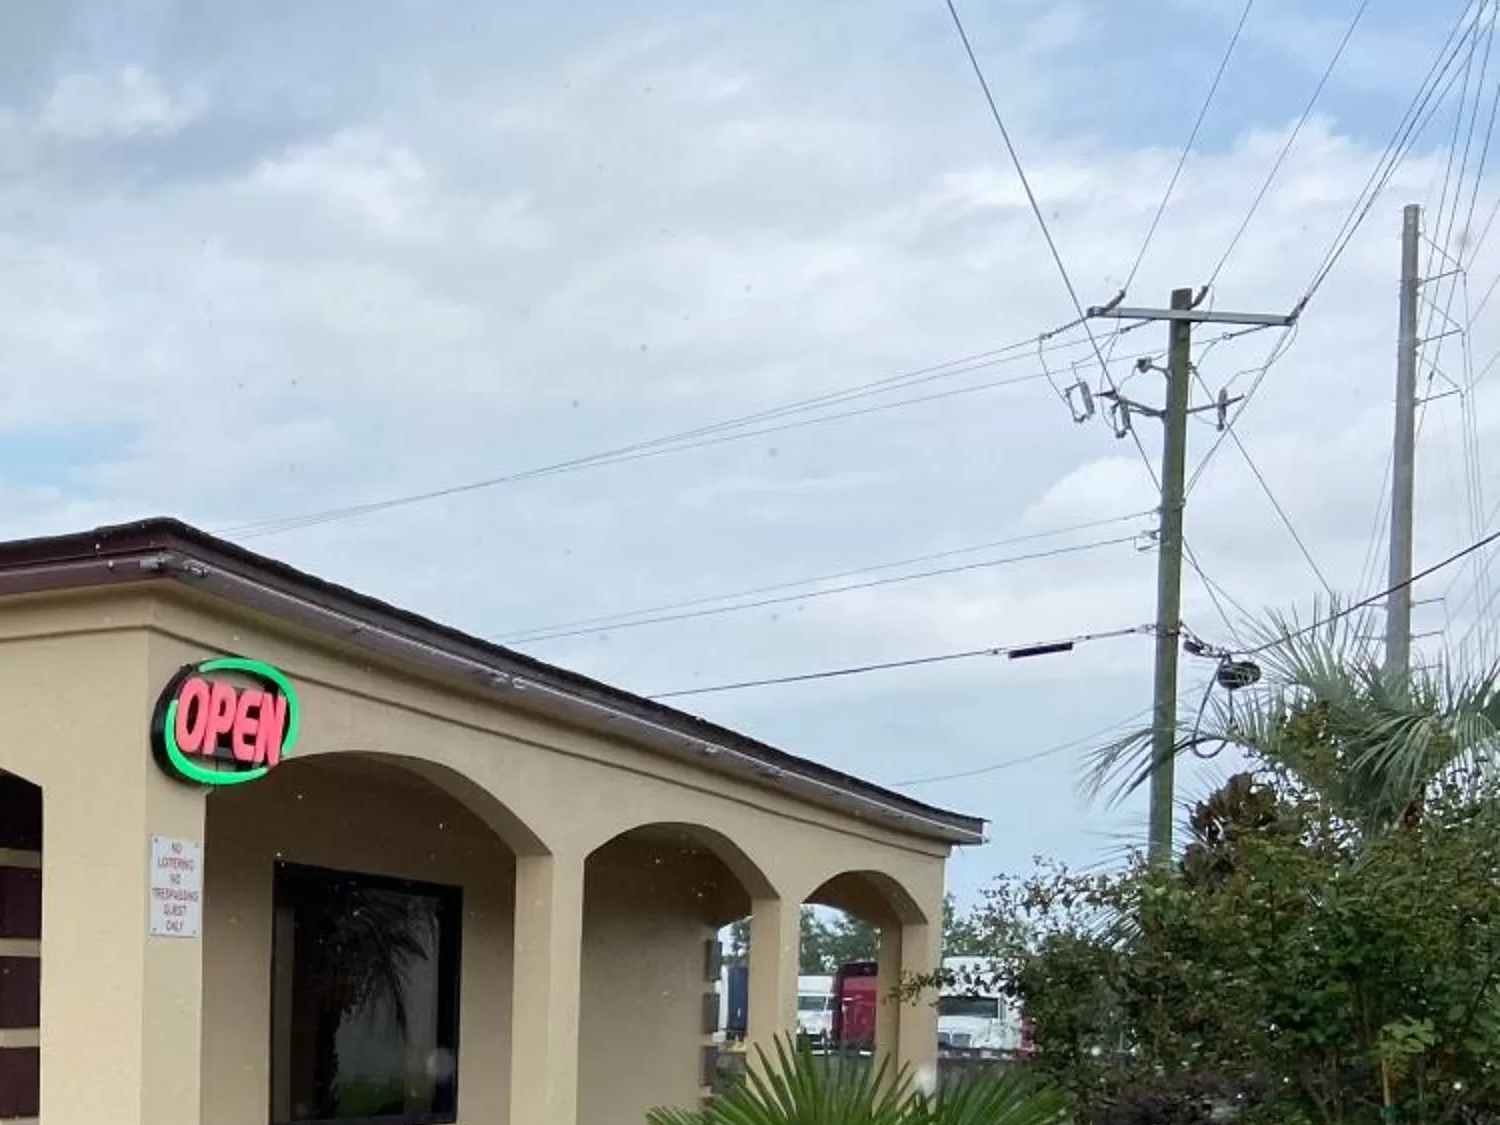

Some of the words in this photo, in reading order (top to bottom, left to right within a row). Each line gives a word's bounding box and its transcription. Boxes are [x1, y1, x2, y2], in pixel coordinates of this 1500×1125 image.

[175, 676, 286, 767] OPEN
[171, 842, 182, 854] NO
[157, 856, 195, 873] LOITERING
[169, 873, 181, 886] NO
